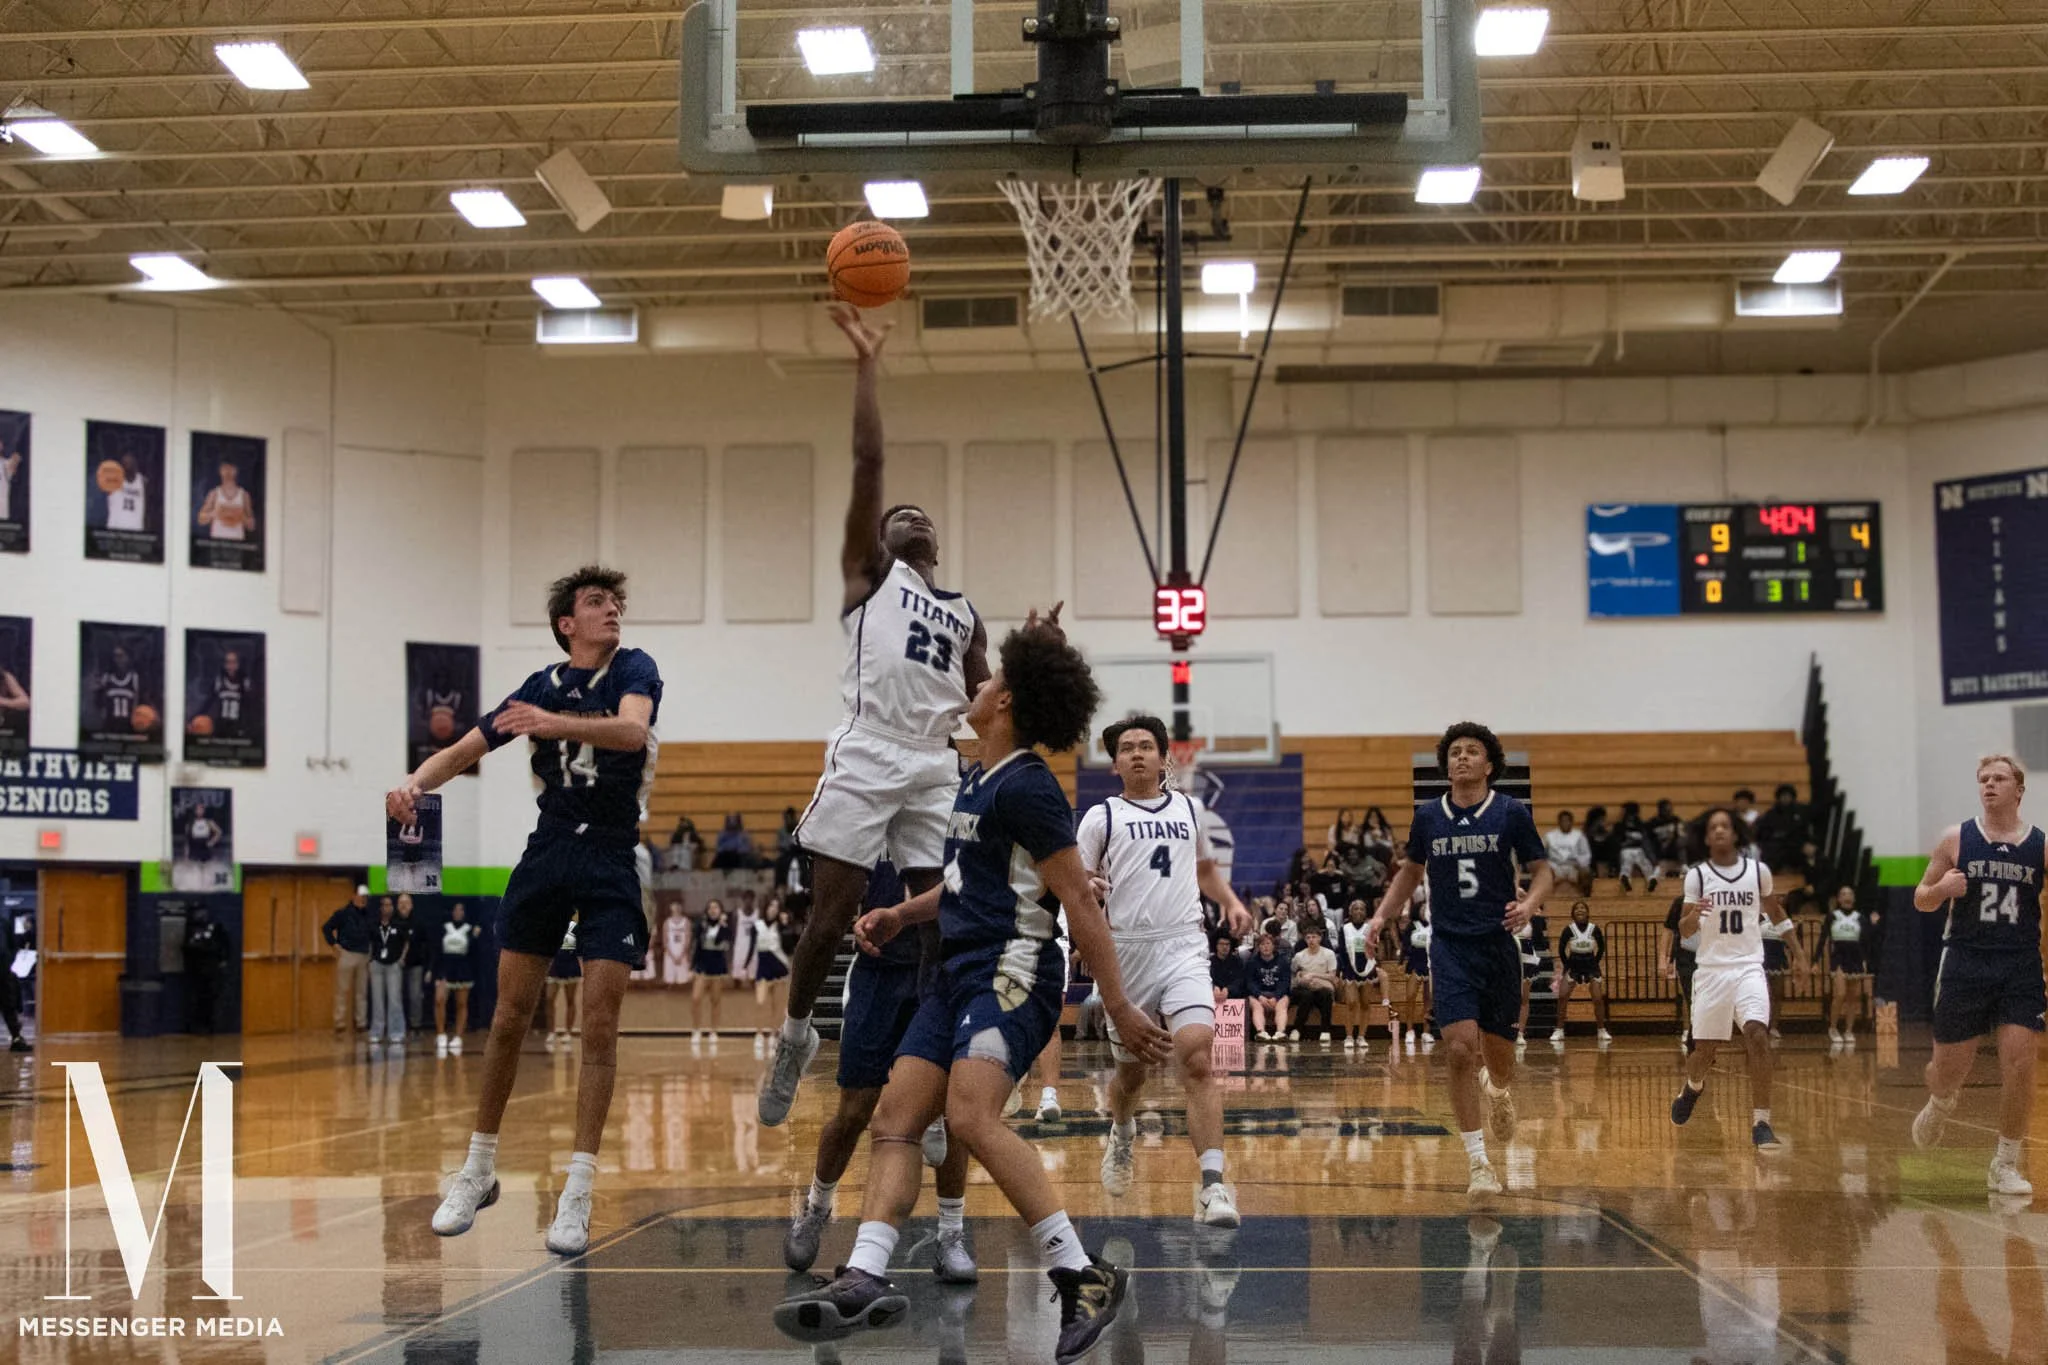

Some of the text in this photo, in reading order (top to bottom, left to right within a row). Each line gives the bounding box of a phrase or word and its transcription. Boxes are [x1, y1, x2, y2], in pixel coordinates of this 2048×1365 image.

[1940, 485, 1964, 510] N
[1711, 523, 1730, 552] 9
[1850, 521, 1870, 549] 4
[900, 587, 970, 641] TITANS
[1156, 589, 1205, 631] 32
[904, 619, 953, 673] 23
[558, 740, 599, 787] 14
[1125, 820, 1190, 841] TITANS
[1432, 834, 1500, 856] ST. PIUS X
[1150, 845, 1172, 878] 4
[1967, 860, 1988, 878] ST.
[1988, 860, 2022, 881] PIUS
[1457, 858, 1480, 899] 5
[1710, 890, 1753, 907] TITANS
[1979, 882, 2020, 925] 24
[1719, 909, 1744, 935] 10
[1222, 1003, 1244, 1017] FAV
